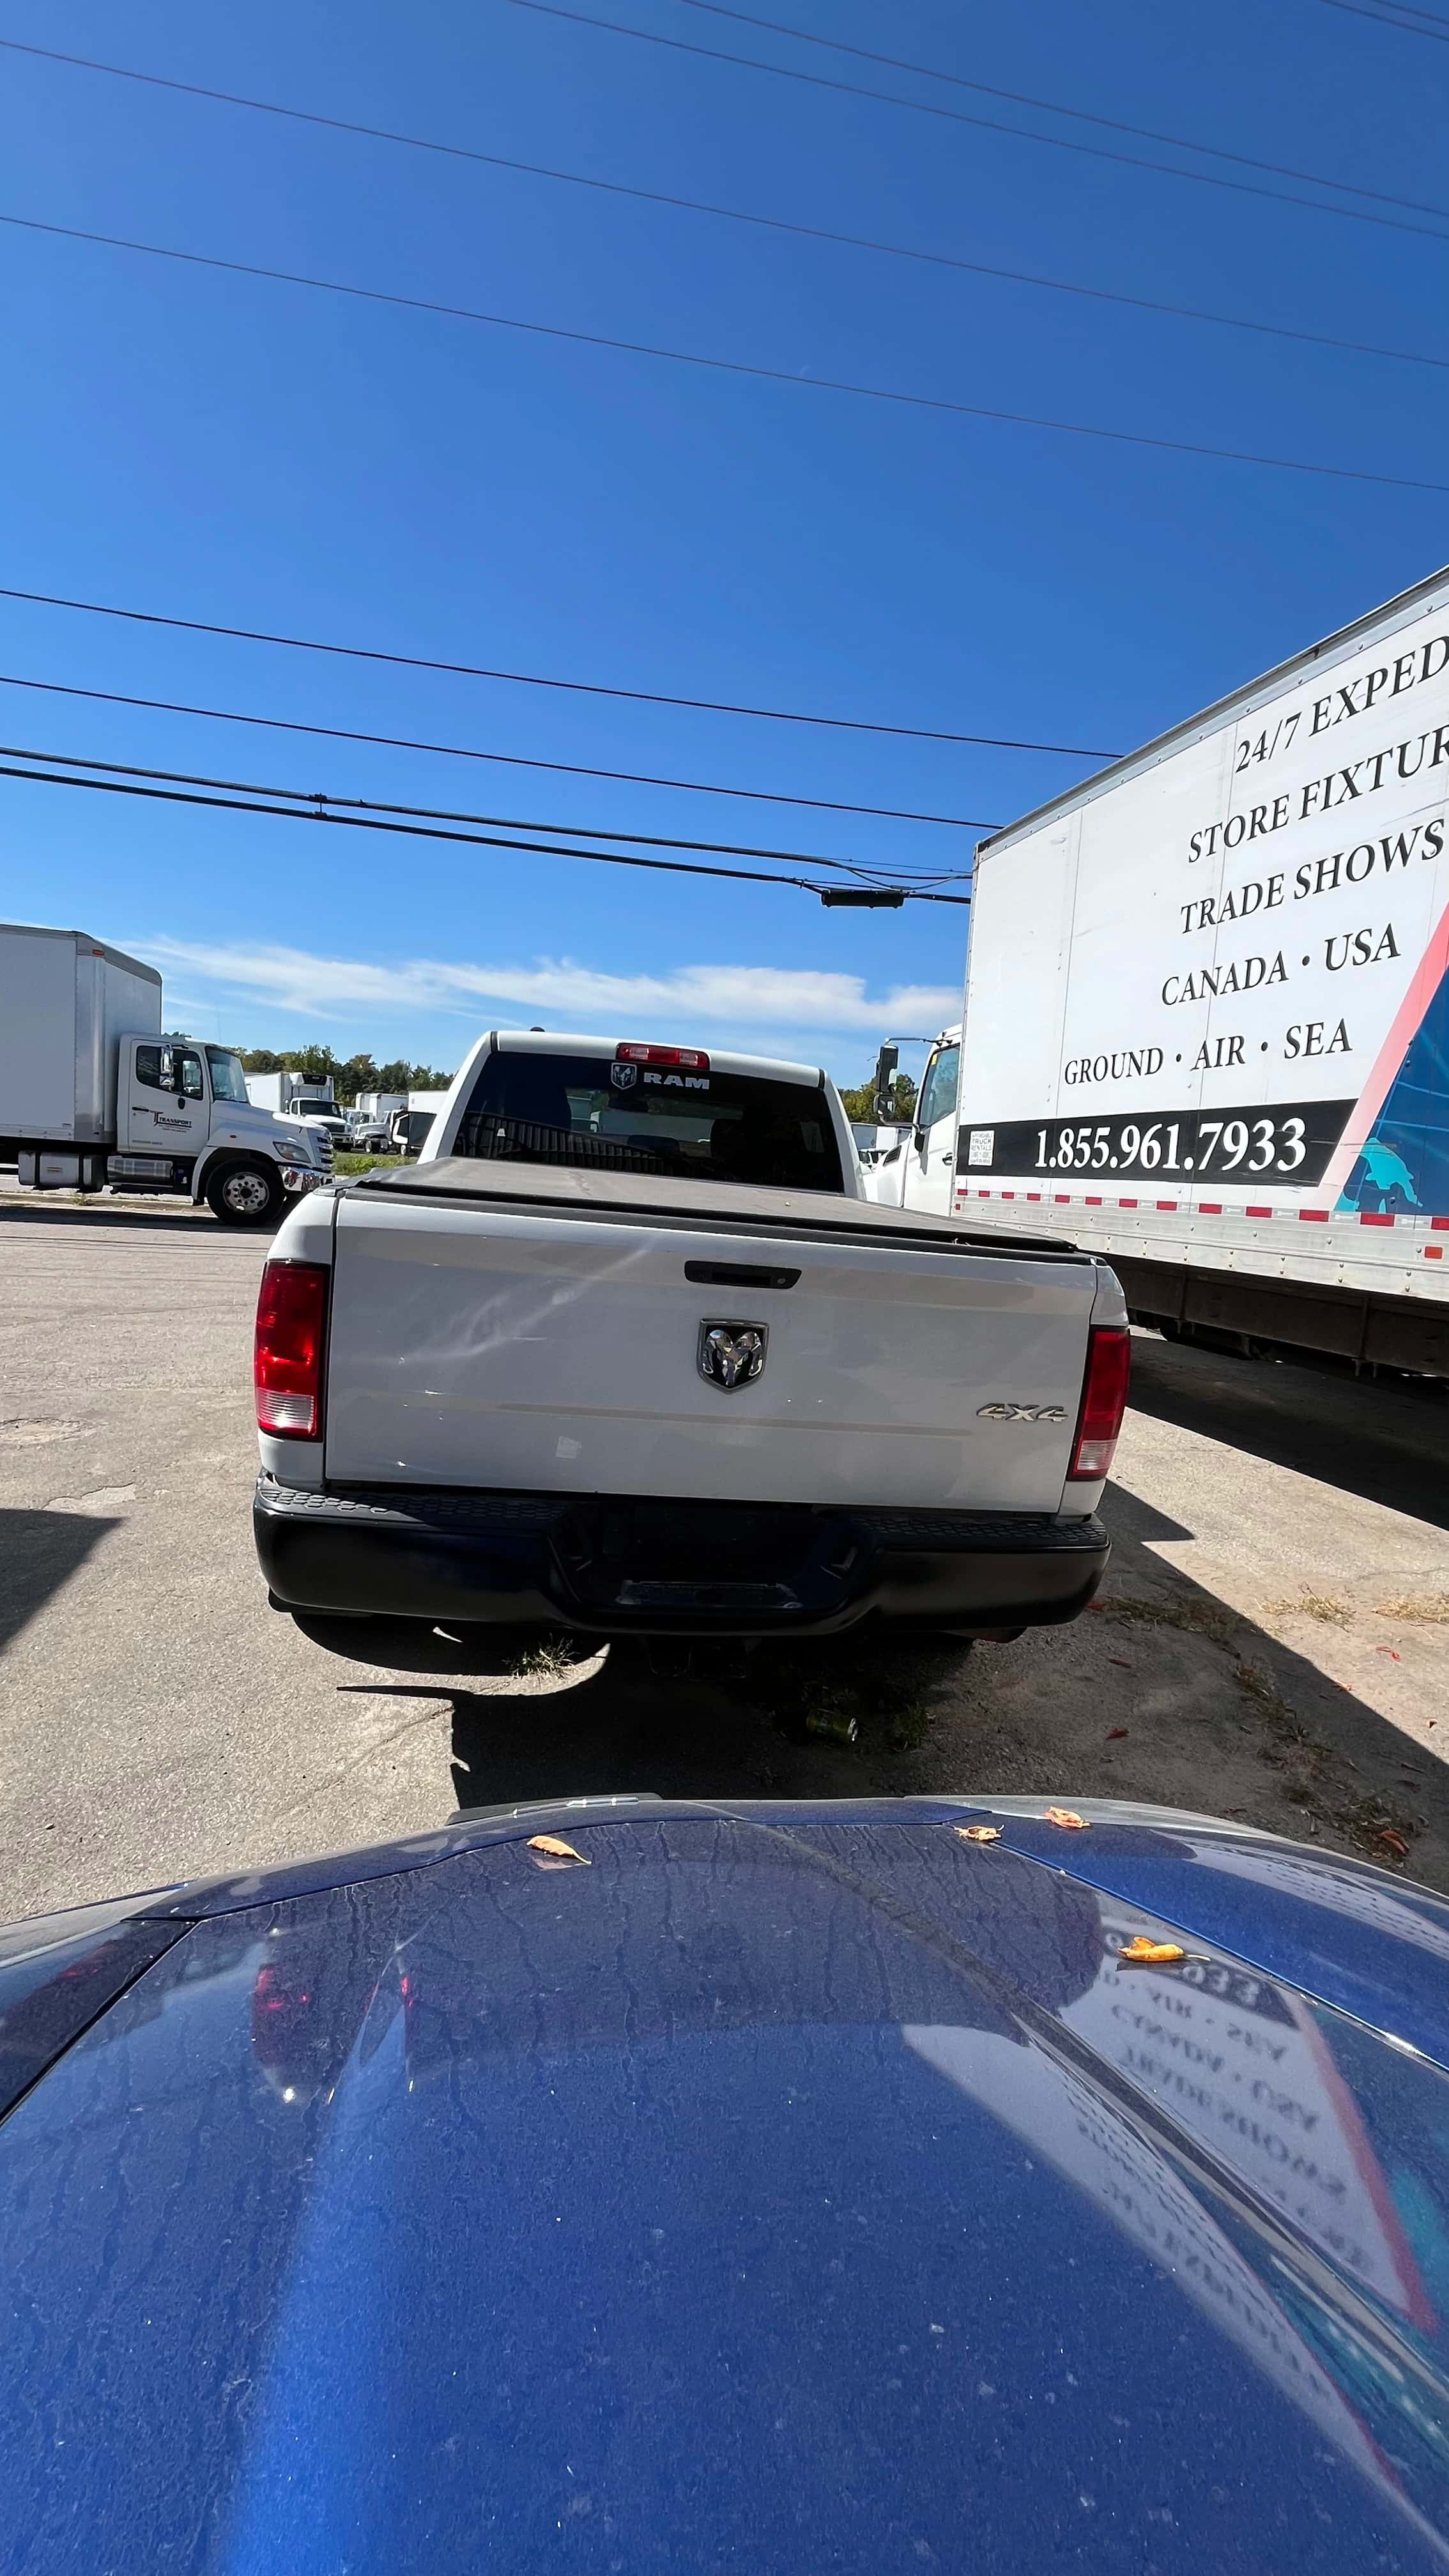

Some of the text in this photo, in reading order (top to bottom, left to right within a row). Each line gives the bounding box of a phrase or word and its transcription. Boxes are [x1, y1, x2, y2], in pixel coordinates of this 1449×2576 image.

[1236, 635, 1449, 773] 24/7 EXPED
[1188, 793, 1289, 863] STORE
[1181, 818, 1445, 934] TRADE SHOWS
[1162, 923, 1401, 1006] CANADA USA
[643, 1072, 709, 1090] RAM
[1064, 1018, 1353, 1085] GROUND AIR SEA
[159, 1117, 192, 1126] TRANSPORT
[1034, 1117, 1307, 1171] 1.855.961.7933
